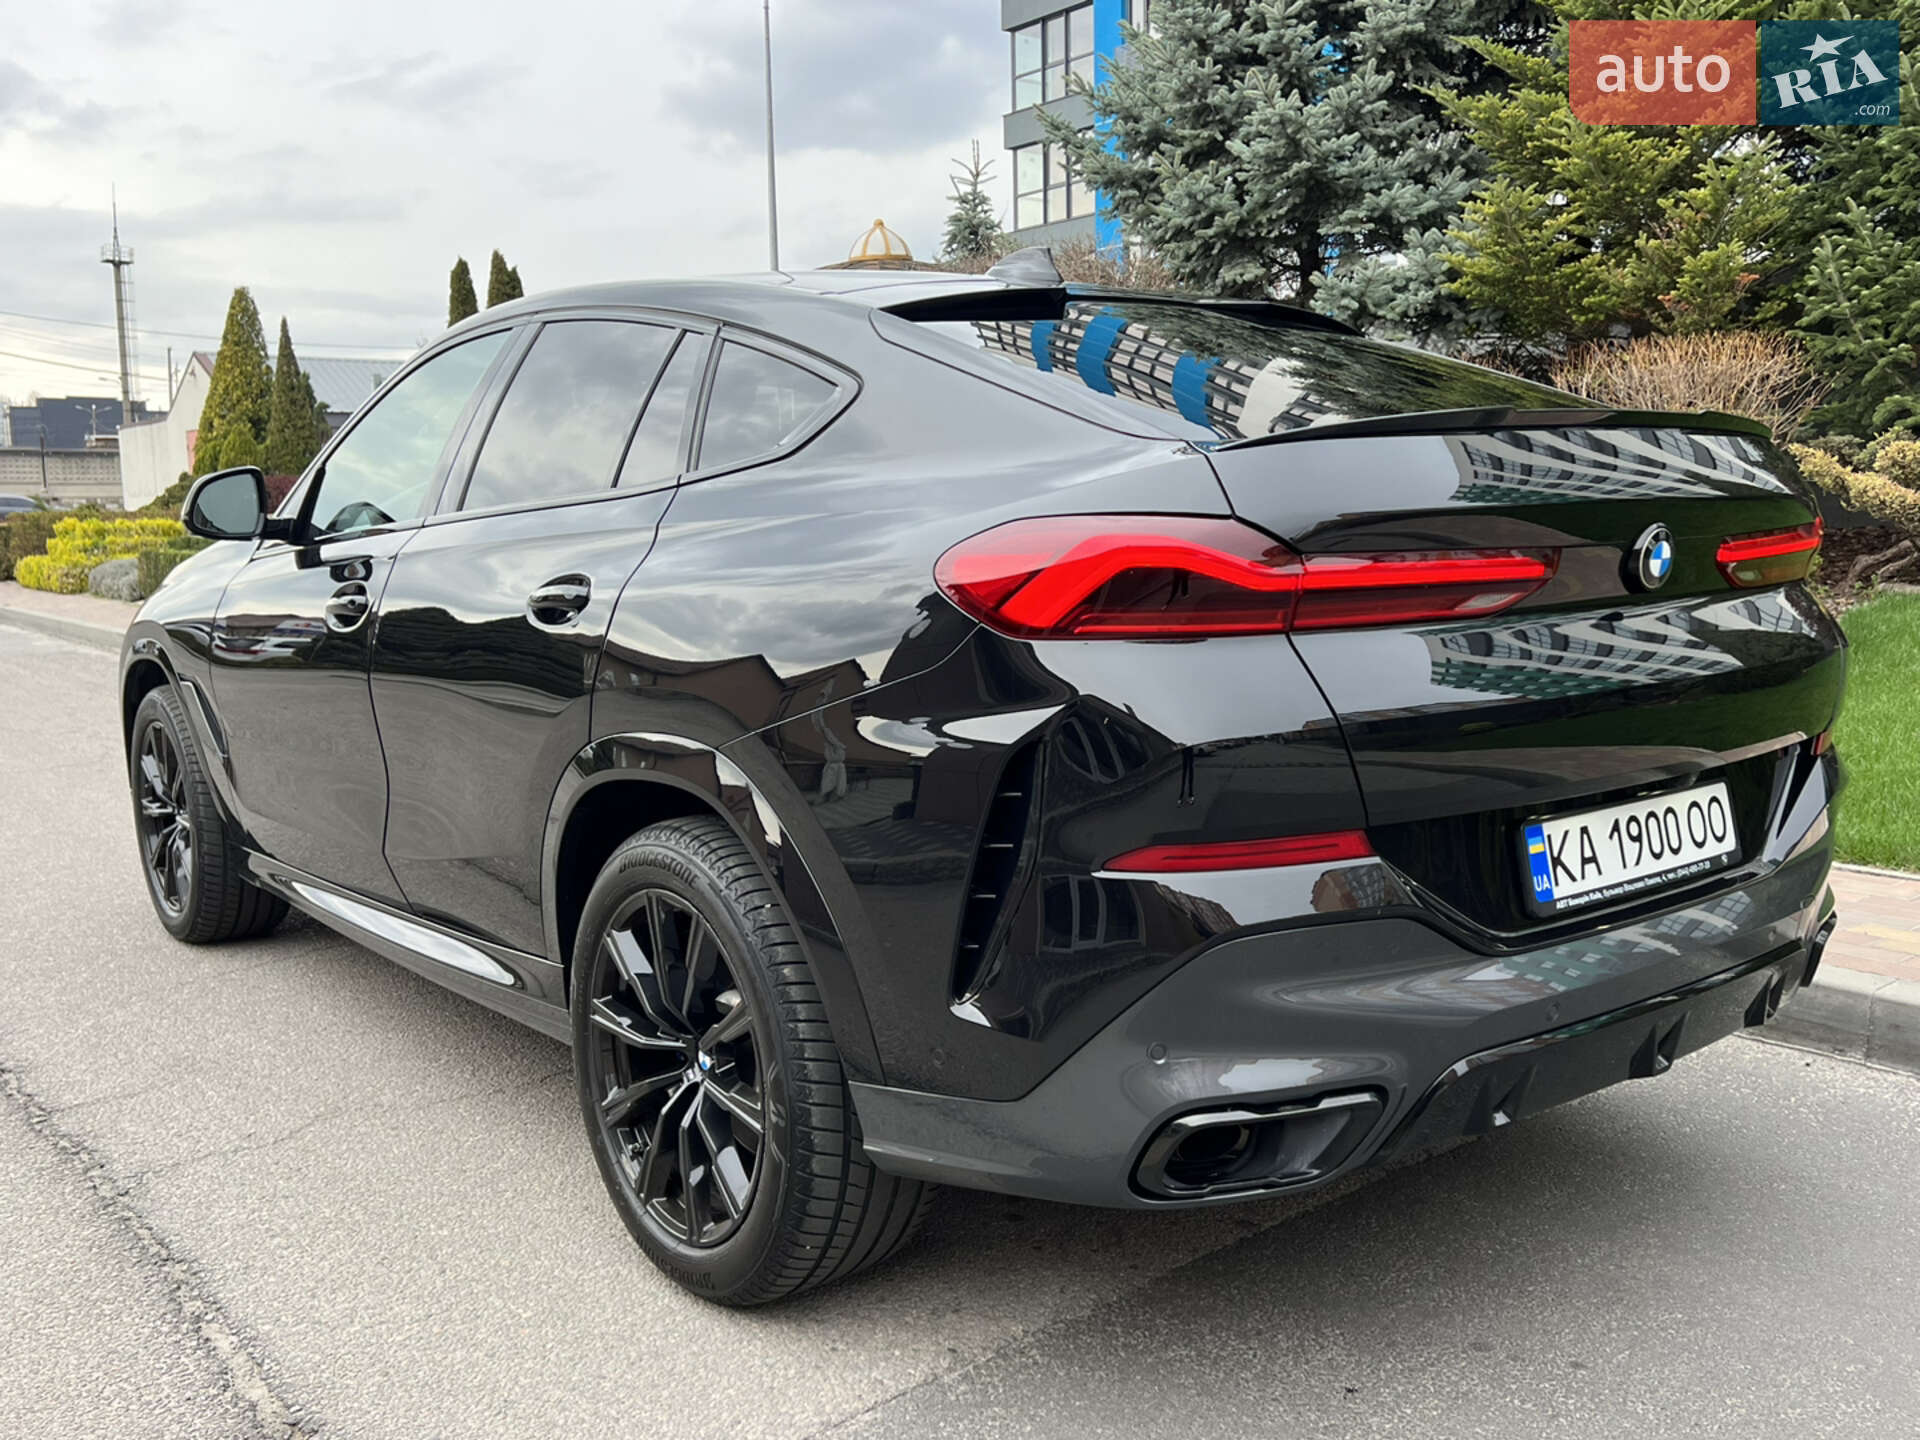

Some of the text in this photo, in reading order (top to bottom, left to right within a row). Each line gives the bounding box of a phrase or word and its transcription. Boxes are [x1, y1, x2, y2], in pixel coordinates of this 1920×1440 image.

[1547, 825, 1602, 887] KA
[1608, 806, 1682, 869] 1900
[1533, 874, 1551, 892] UA
